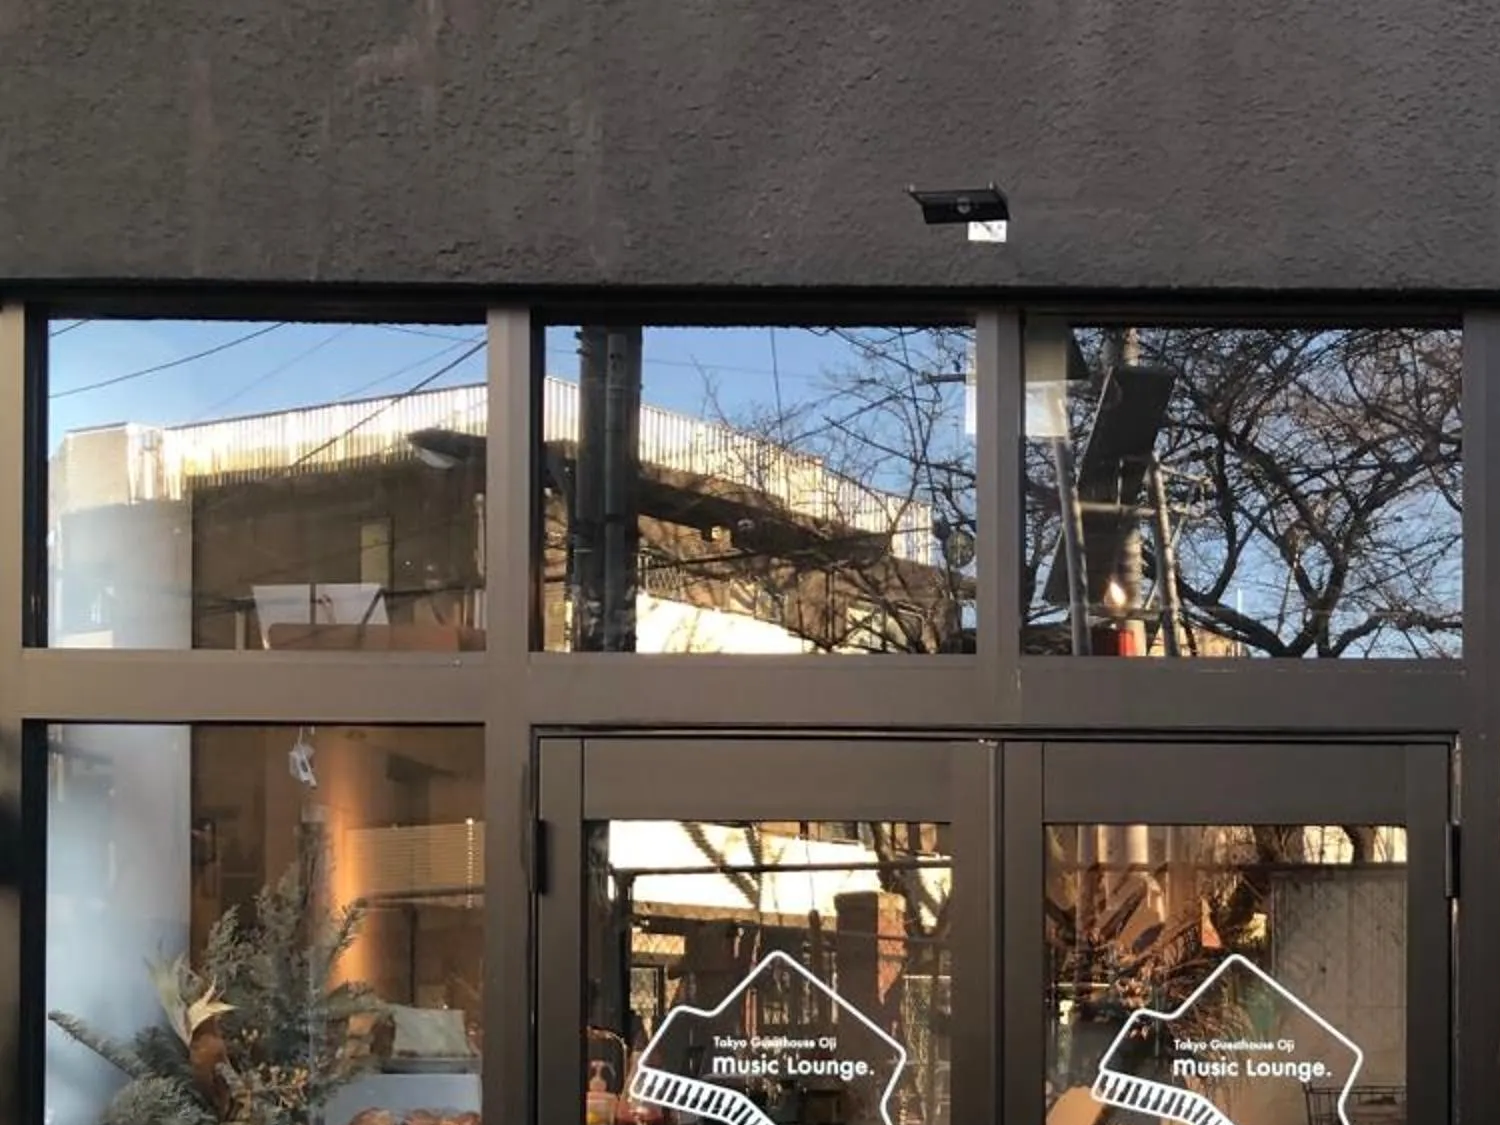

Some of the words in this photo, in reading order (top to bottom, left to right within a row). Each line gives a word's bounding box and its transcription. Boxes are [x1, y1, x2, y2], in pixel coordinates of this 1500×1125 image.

[713, 1036, 747, 1050] Tokyo
[751, 1036, 815, 1049] Guesthouse
[819, 1036, 837, 1050] Oji
[1174, 1040, 1207, 1052] Tokyo
[1210, 1040, 1274, 1051] Guesthouse
[1278, 1039, 1295, 1053] Oji
[786, 1058, 875, 1080] Lounge.
[1246, 1059, 1332, 1082] Lounge.
